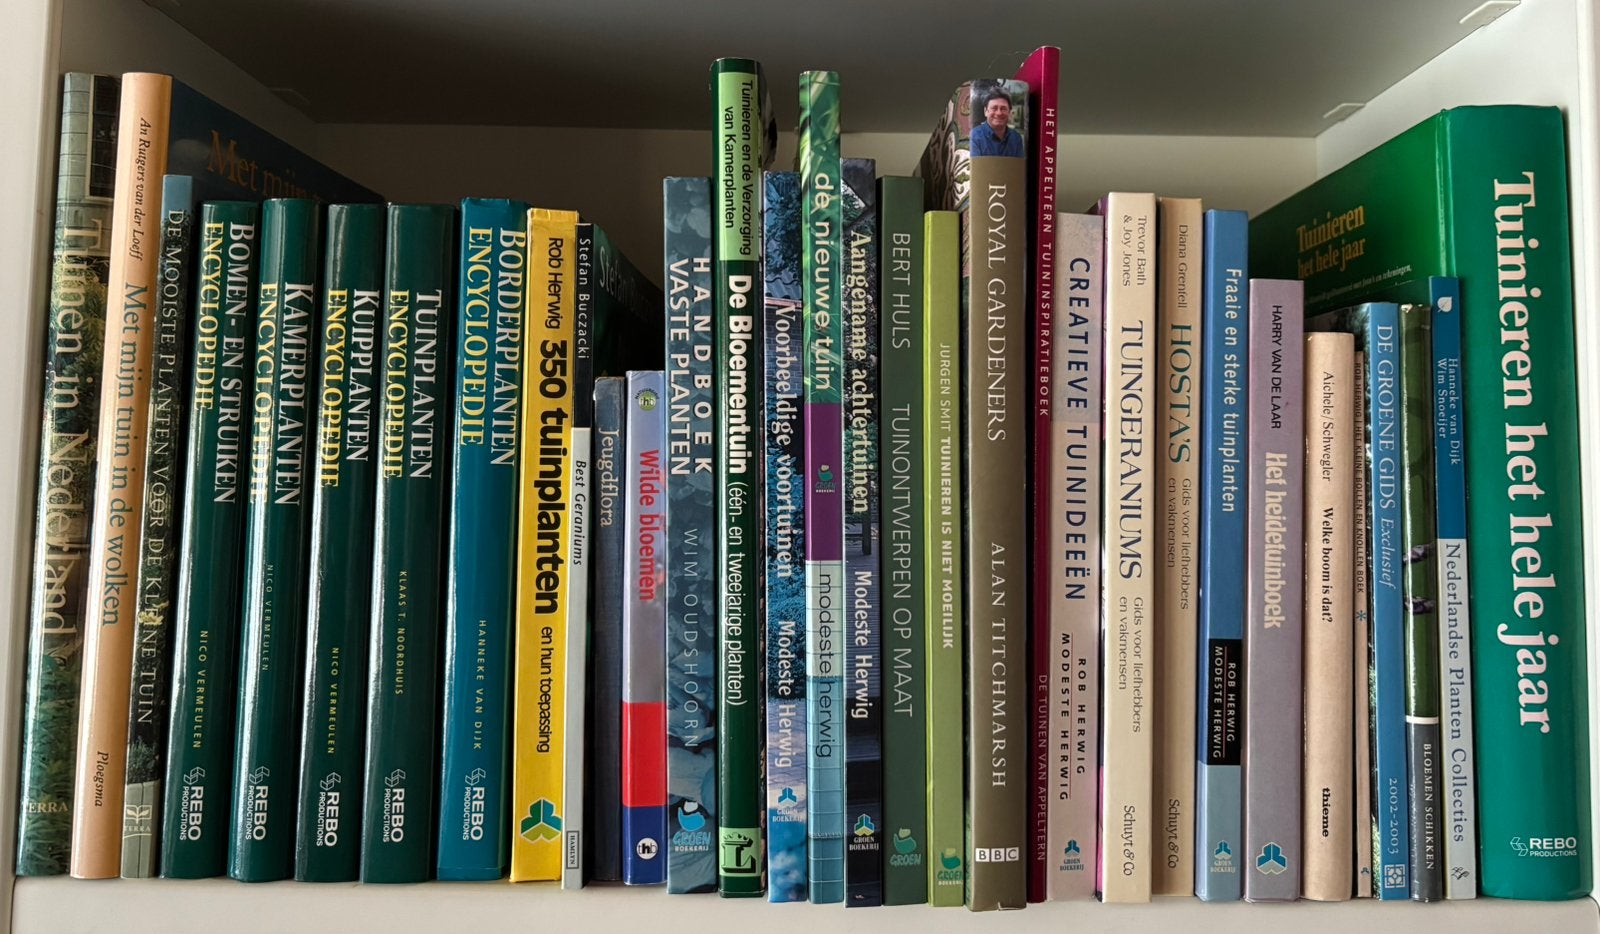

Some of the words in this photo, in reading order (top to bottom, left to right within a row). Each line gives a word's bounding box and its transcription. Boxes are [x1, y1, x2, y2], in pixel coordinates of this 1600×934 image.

[139, 117, 152, 136] An
[724, 106, 734, 130] van
[741, 80, 753, 141] Tuinieren
[1045, 108, 1055, 138] HET
[135, 139, 152, 181] Rutgers
[722, 134, 737, 229] Kamerplanten
[741, 144, 751, 159] en
[741, 162, 753, 179] de
[133, 204, 147, 226] der
[135, 182, 146, 203] van
[739, 181, 753, 256] Verzorging
[814, 172, 835, 209] de
[1043, 146, 1054, 232] APPELTERN
[1123, 214, 1132, 224] &
[128, 228, 146, 262] Loeff
[167, 209, 185, 238] DE
[548, 237, 564, 269] Rob
[988, 184, 1006, 269] ROYAL
[1122, 226, 1134, 244] Joy
[1138, 215, 1147, 252] Trevor
[1296, 204, 1365, 254] Tuinieren
[57, 219, 101, 354] Tuinen
[224, 223, 255, 327] BOMEN-
[579, 238, 591, 286] Stefan
[814, 220, 835, 328] nieuwe
[892, 233, 911, 285] BERT
[1123, 251, 1132, 286] Jones
[1137, 255, 1147, 286] Bath
[123, 281, 148, 334] Met
[161, 247, 183, 344] MOOISTE
[194, 221, 225, 411] ENCYCLOPEDIE
[545, 273, 564, 330] Herwig
[669, 259, 689, 341] VASTE
[728, 275, 752, 309] De
[847, 230, 872, 361] Aangename
[1224, 268, 1242, 319] Fraaie
[1493, 171, 1541, 410] Tuinieren
[220, 336, 245, 368] EN
[460, 226, 493, 446] ENCYCLOPEDIE
[490, 227, 527, 467] BORDERPLANTEN
[577, 293, 590, 359] Buczacki
[892, 296, 911, 349] HULS
[1039, 243, 1052, 416] TUININSPIRATIEBOEK
[1067, 257, 1090, 409] CREATIEVE
[1225, 327, 1237, 346] en
[1271, 305, 1283, 346] HARRY
[1376, 325, 1393, 353] DE
[113, 338, 145, 399] mijn
[320, 288, 348, 488] ENCYCLOPEDIE
[346, 289, 380, 462] KUIPPLANTEN
[384, 289, 410, 479] ENCYCLOPEDIE
[410, 289, 443, 479] TUINPLANTEN
[539, 340, 568, 399] 350
[771, 302, 798, 446] Voorbeeldige
[815, 338, 835, 390] tuin
[940, 343, 951, 395] JURGEN
[987, 278, 1006, 441] GARDENERS
[1223, 354, 1241, 406] sterke
[1271, 350, 1282, 377] VAN
[1271, 378, 1281, 392] DE
[52, 375, 94, 409] in
[153, 353, 176, 455] PLANTEN
[250, 282, 278, 503] ENCYCLOPEDIE
[274, 282, 313, 506] KAMERPLANTEN
[670, 354, 690, 475] PLANTEN
[728, 315, 753, 474] Bloementuin
[940, 398, 951, 431] SMIT
[1271, 396, 1281, 429] LAAR
[1377, 360, 1395, 451] GROENE
[113, 404, 139, 457] tuin
[214, 378, 242, 504] STRUIKEN
[852, 368, 874, 513] achtertuinen
[1119, 320, 1143, 579] TUINGERANIUMS
[1319, 371, 1336, 482] Aichele/Schwegler
[111, 466, 137, 490] in
[575, 460, 587, 487] Best
[596, 429, 619, 527] Jeugdflora
[639, 449, 660, 506] Wilde
[940, 436, 952, 516] TUINIEREN
[1218, 412, 1240, 512] tuinplanten
[1265, 452, 1287, 485] Het
[1379, 458, 1396, 509] GIDS
[1504, 422, 1548, 501] het
[109, 497, 134, 528] de
[149, 467, 169, 527] VOOR
[534, 408, 568, 615] tuinplanten
[776, 453, 801, 578] voortuinen
[892, 403, 911, 599] TUINONTWERPEN
[1065, 426, 1091, 599] TUINIDEEËN
[1322, 507, 1334, 544] Welke
[43, 429, 91, 635] Nederland
[146, 539, 165, 566] DE
[573, 493, 586, 566] Geraniums
[639, 515, 661, 601] bloemen
[728, 529, 743, 546] en
[941, 522, 952, 534] IS
[941, 540, 952, 574] NIET
[1378, 518, 1396, 589] Exclusief
[102, 533, 130, 627] wolken
[991, 542, 1006, 607] ALAN
[1263, 490, 1288, 629] heidetuinboek
[1322, 548, 1334, 582] boom
[1322, 584, 1332, 595] is
[1509, 513, 1556, 619] hele
[725, 552, 748, 636] tweejarige
[818, 574, 835, 674] modeste
[854, 571, 873, 647] Modeste
[893, 607, 912, 640] OP
[942, 579, 953, 648] MOEILIJK
[1133, 597, 1143, 626] Gids
[1322, 597, 1333, 624] dat?
[1446, 543, 1463, 660] Nederlandse
[331, 647, 339, 676] NICO
[540, 626, 553, 643] en
[540, 646, 553, 676] hun
[777, 620, 797, 697] Modeste
[1134, 630, 1142, 659] voor
[138, 667, 157, 723] TUIN
[727, 639, 748, 706] planten)
[851, 654, 873, 719] Herwig
[893, 649, 912, 717] MAAT
[1038, 675, 1048, 691] DE
[1061, 633, 1070, 717] MODESTE
[1133, 662, 1144, 733] liefhebbers
[1496, 623, 1560, 734] jaar
[327, 683, 338, 754] VERMEULEN
[537, 678, 553, 753] toepassing
[816, 680, 835, 758] herwig
[991, 620, 1007, 787] TITCHMARSH
[1038, 695, 1048, 750] TUINEN
[1449, 667, 1467, 740] Planten
[775, 704, 797, 768] Herwig
[1060, 730, 1069, 800] HERWIG
[93, 751, 109, 807] Ploegsma
[1038, 754, 1047, 782] VAN
[1423, 744, 1433, 801] BLOEMEN
[1451, 748, 1468, 842] Collecties
[188, 786, 204, 840] REBO
[1037, 786, 1047, 861] APPELTERN
[1322, 787, 1331, 837] thieme
[1387, 777, 1400, 854] 2002-2003
[1425, 807, 1435, 870] SCHIKKEN
[890, 853, 921, 867] GROEN
[976, 848, 1018, 862] BBC
[1529, 837, 1577, 849] REBO
[1529, 849, 1577, 857] PRODUCTIONS
